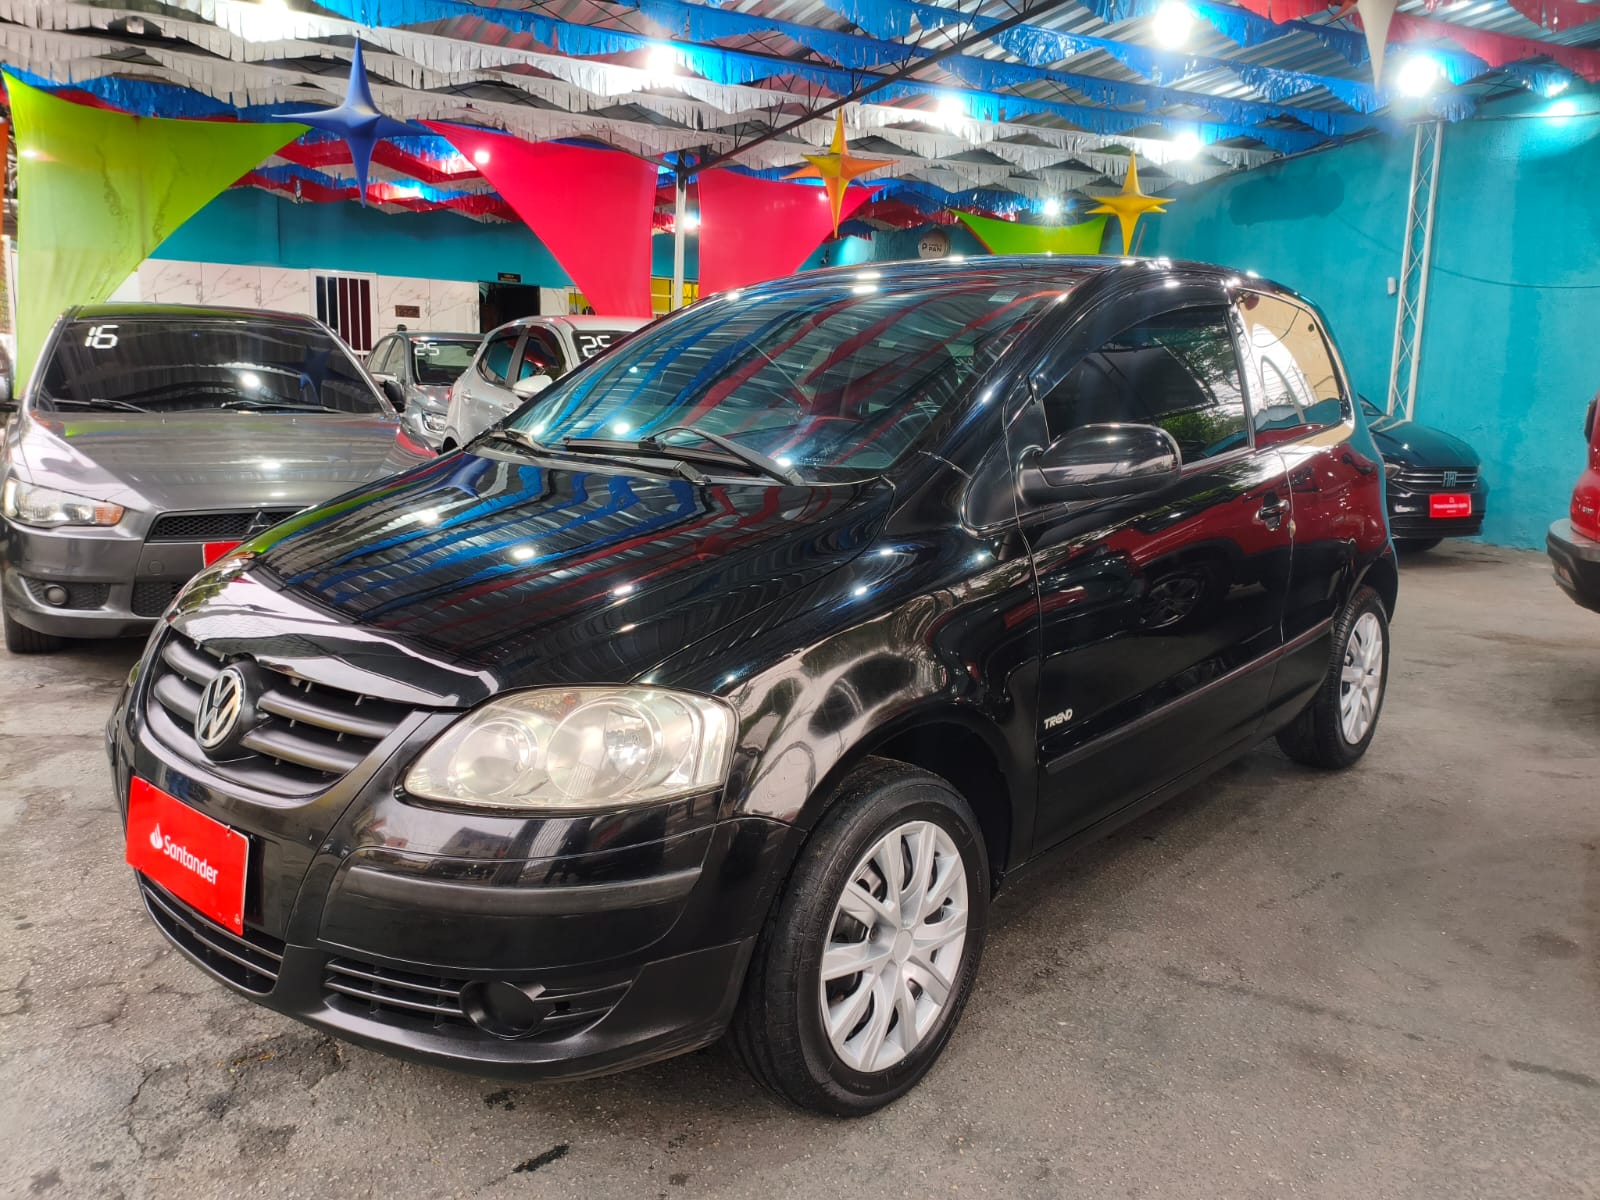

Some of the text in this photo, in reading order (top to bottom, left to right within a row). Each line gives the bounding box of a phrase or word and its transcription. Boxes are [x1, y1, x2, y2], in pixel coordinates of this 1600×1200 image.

[85, 325, 118, 349] 16
[414, 342, 439, 355] 25
[1044, 708, 1073, 730] TREND
[163, 835, 218, 885] Santander
